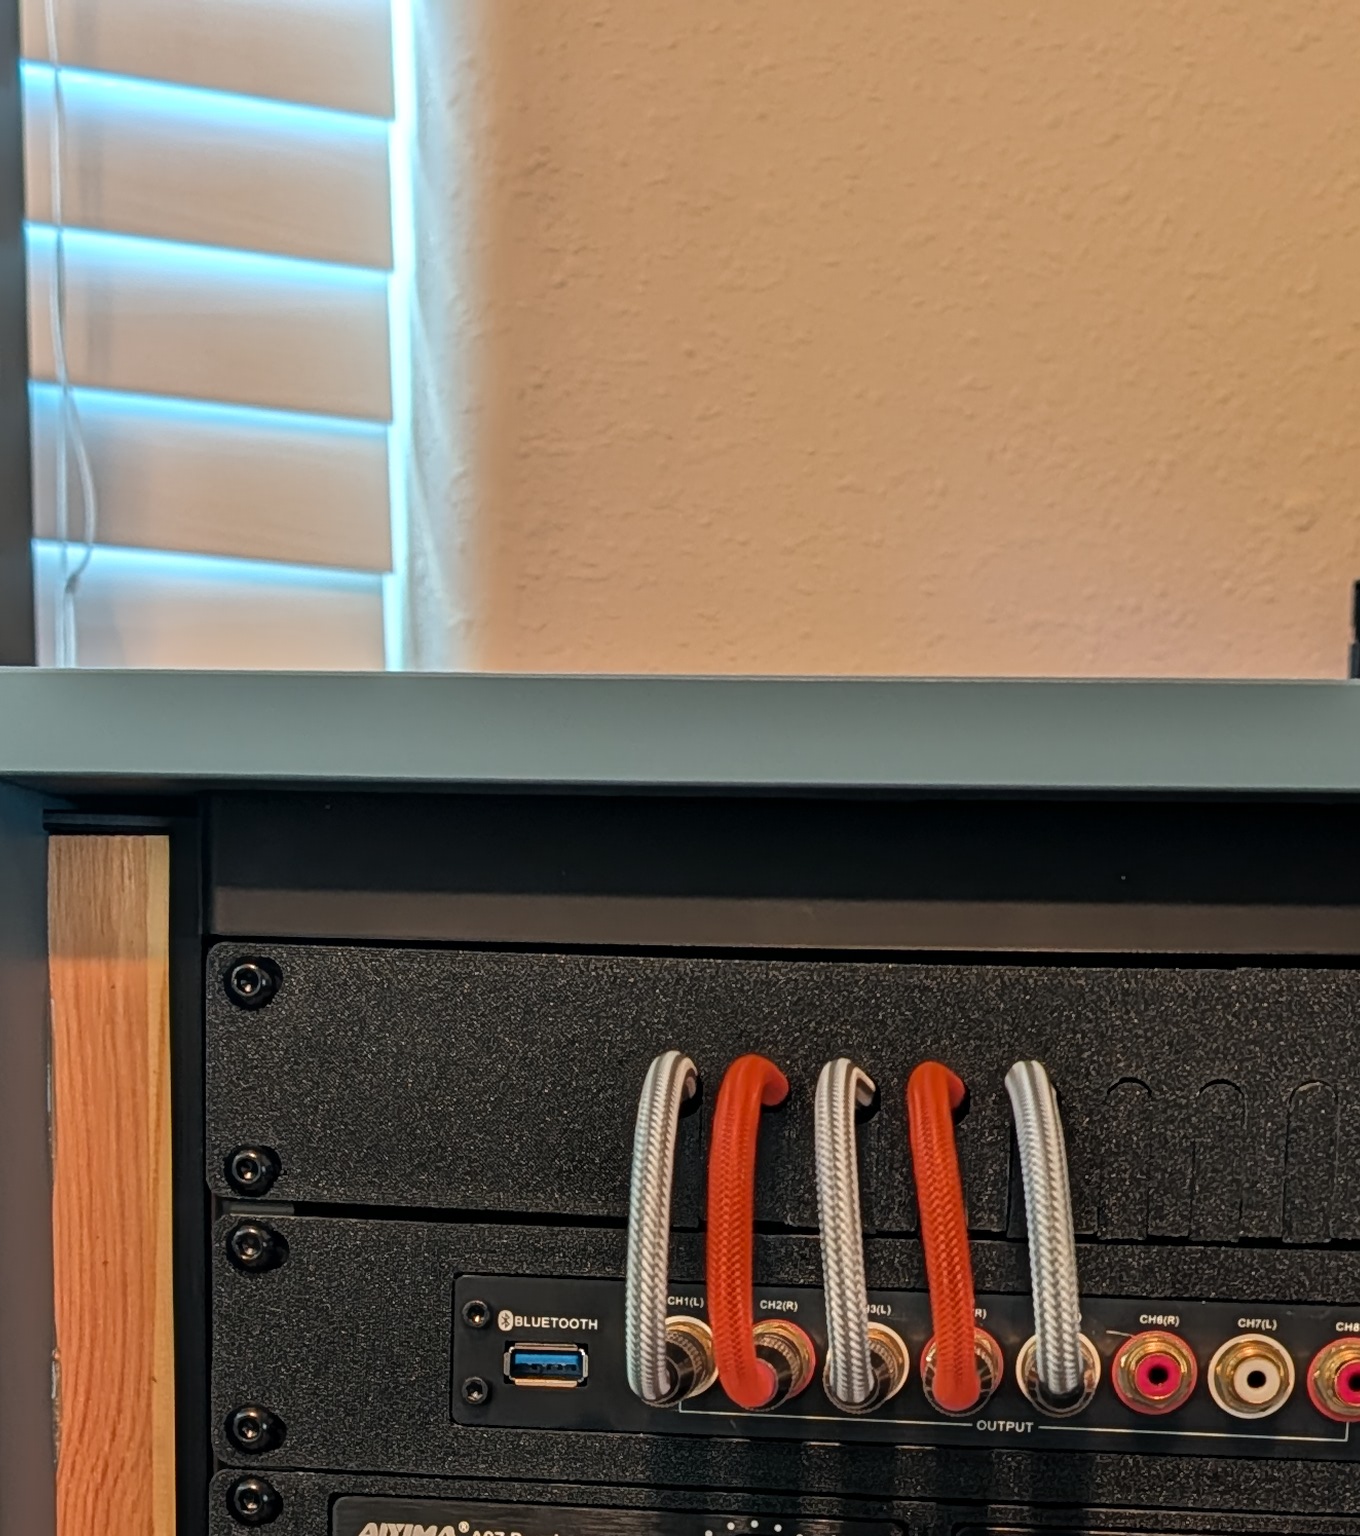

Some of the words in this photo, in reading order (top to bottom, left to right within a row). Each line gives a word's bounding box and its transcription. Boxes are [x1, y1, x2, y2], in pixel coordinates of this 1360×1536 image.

[667, 1295, 704, 1309] CH1(L)
[759, 1299, 799, 1313] CH2(R)
[514, 1315, 599, 1331] BLUETOOTH
[1139, 1314, 1180, 1327] CH6(R)
[1237, 1317, 1278, 1332] CH7(L)
[976, 1420, 1035, 1434] OUTPUT
